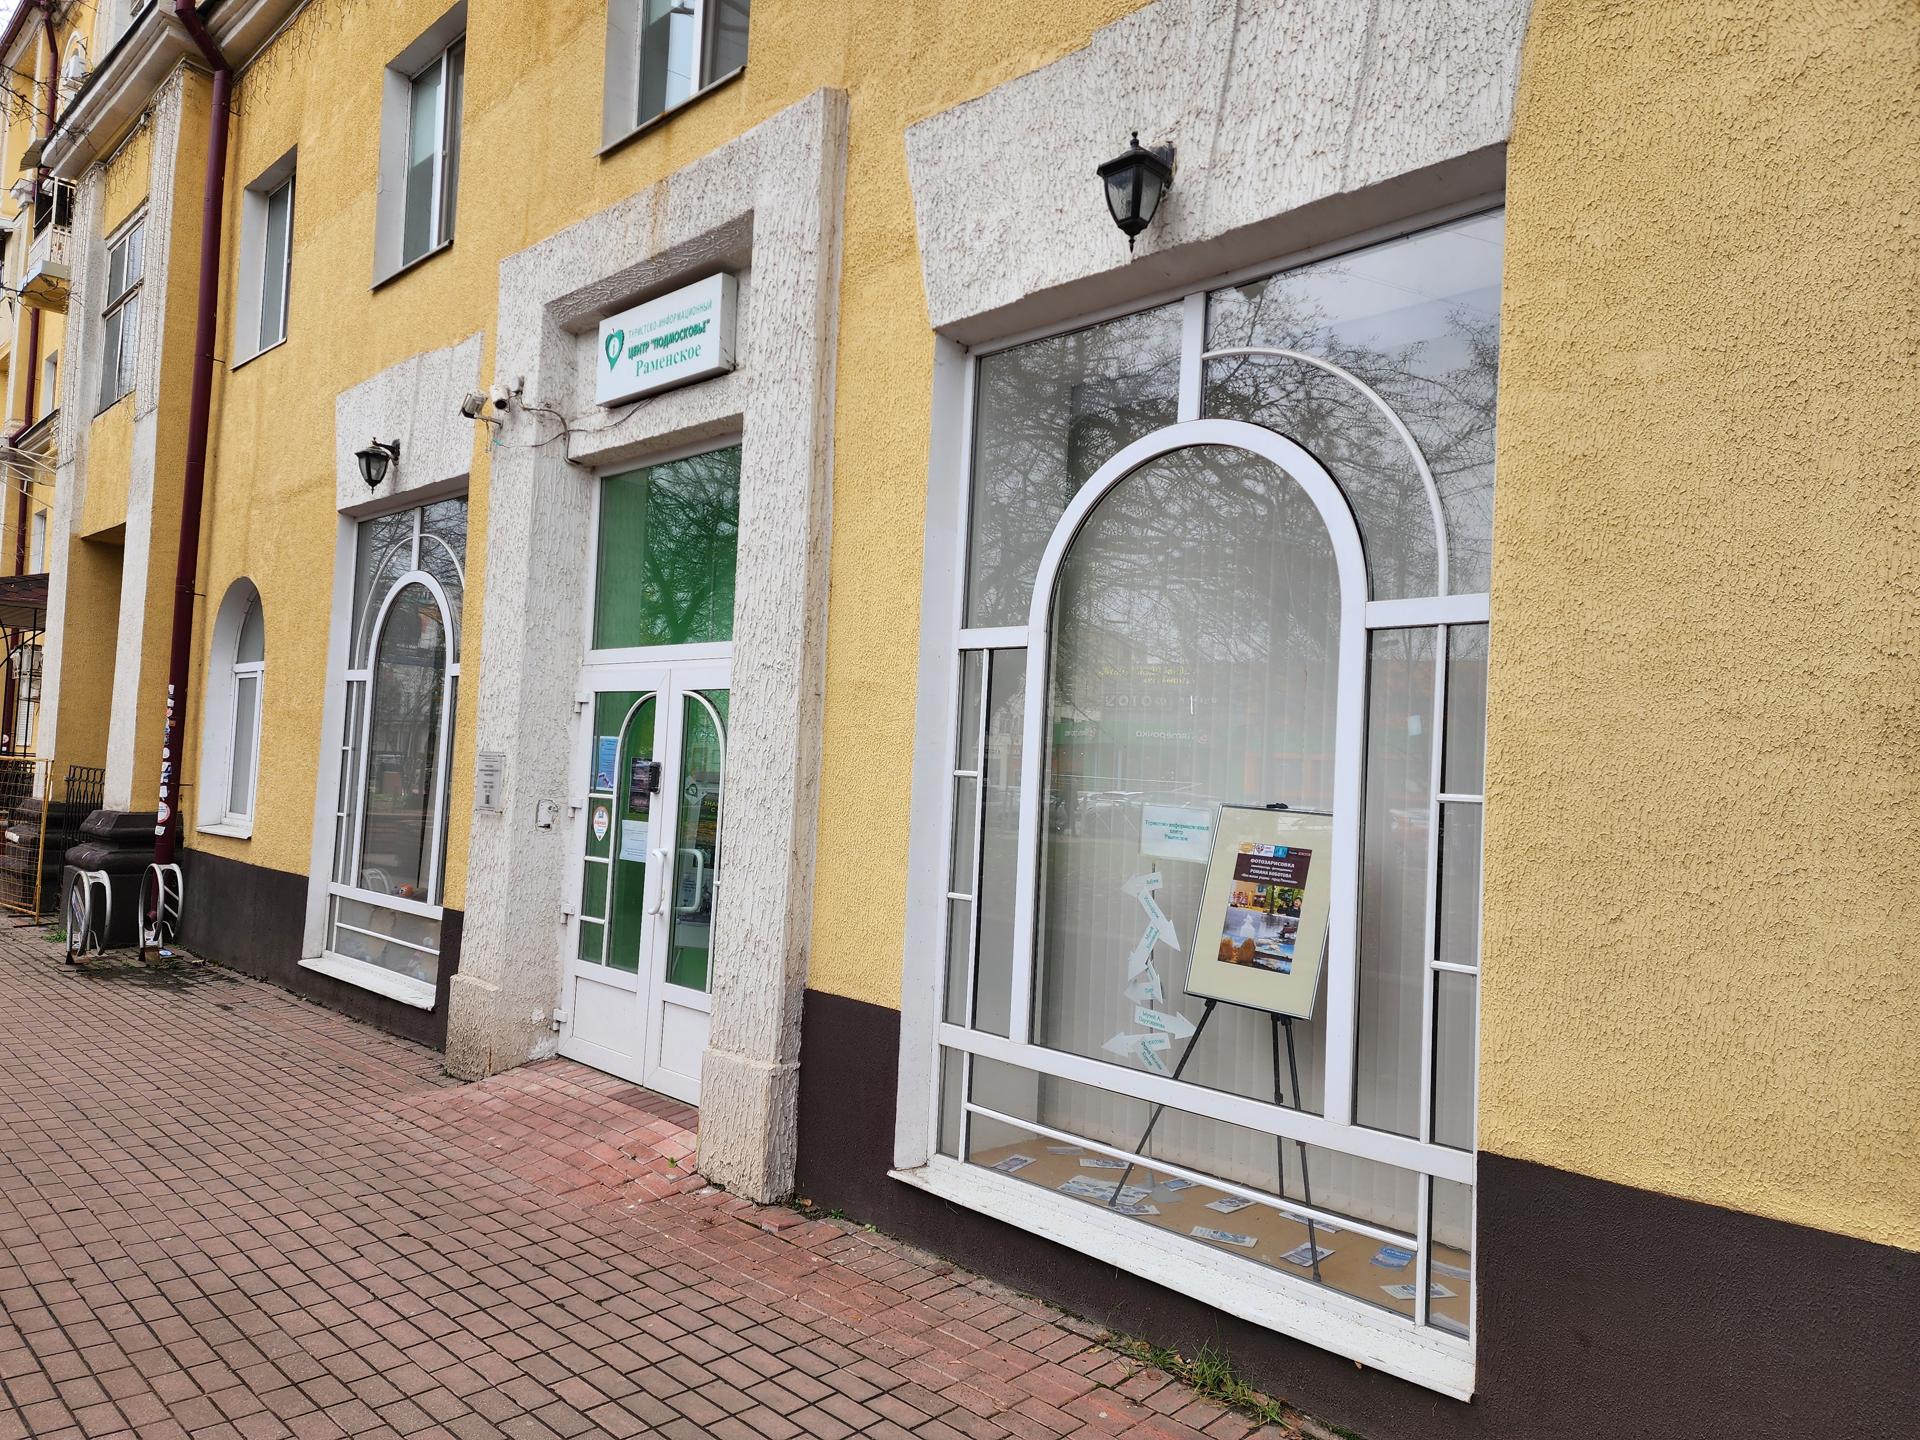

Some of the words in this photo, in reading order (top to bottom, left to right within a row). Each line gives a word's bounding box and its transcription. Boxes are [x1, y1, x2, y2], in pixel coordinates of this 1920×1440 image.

[628, 300, 713, 339] ТУРИСТСКО-ИНФОРМАЦИОННЫЙ
[628, 340, 650, 360] ЦЕНТР
[651, 319, 711, 351] "ПОДМОСКОВЬЕ"
[636, 344, 702, 377] Раменское
